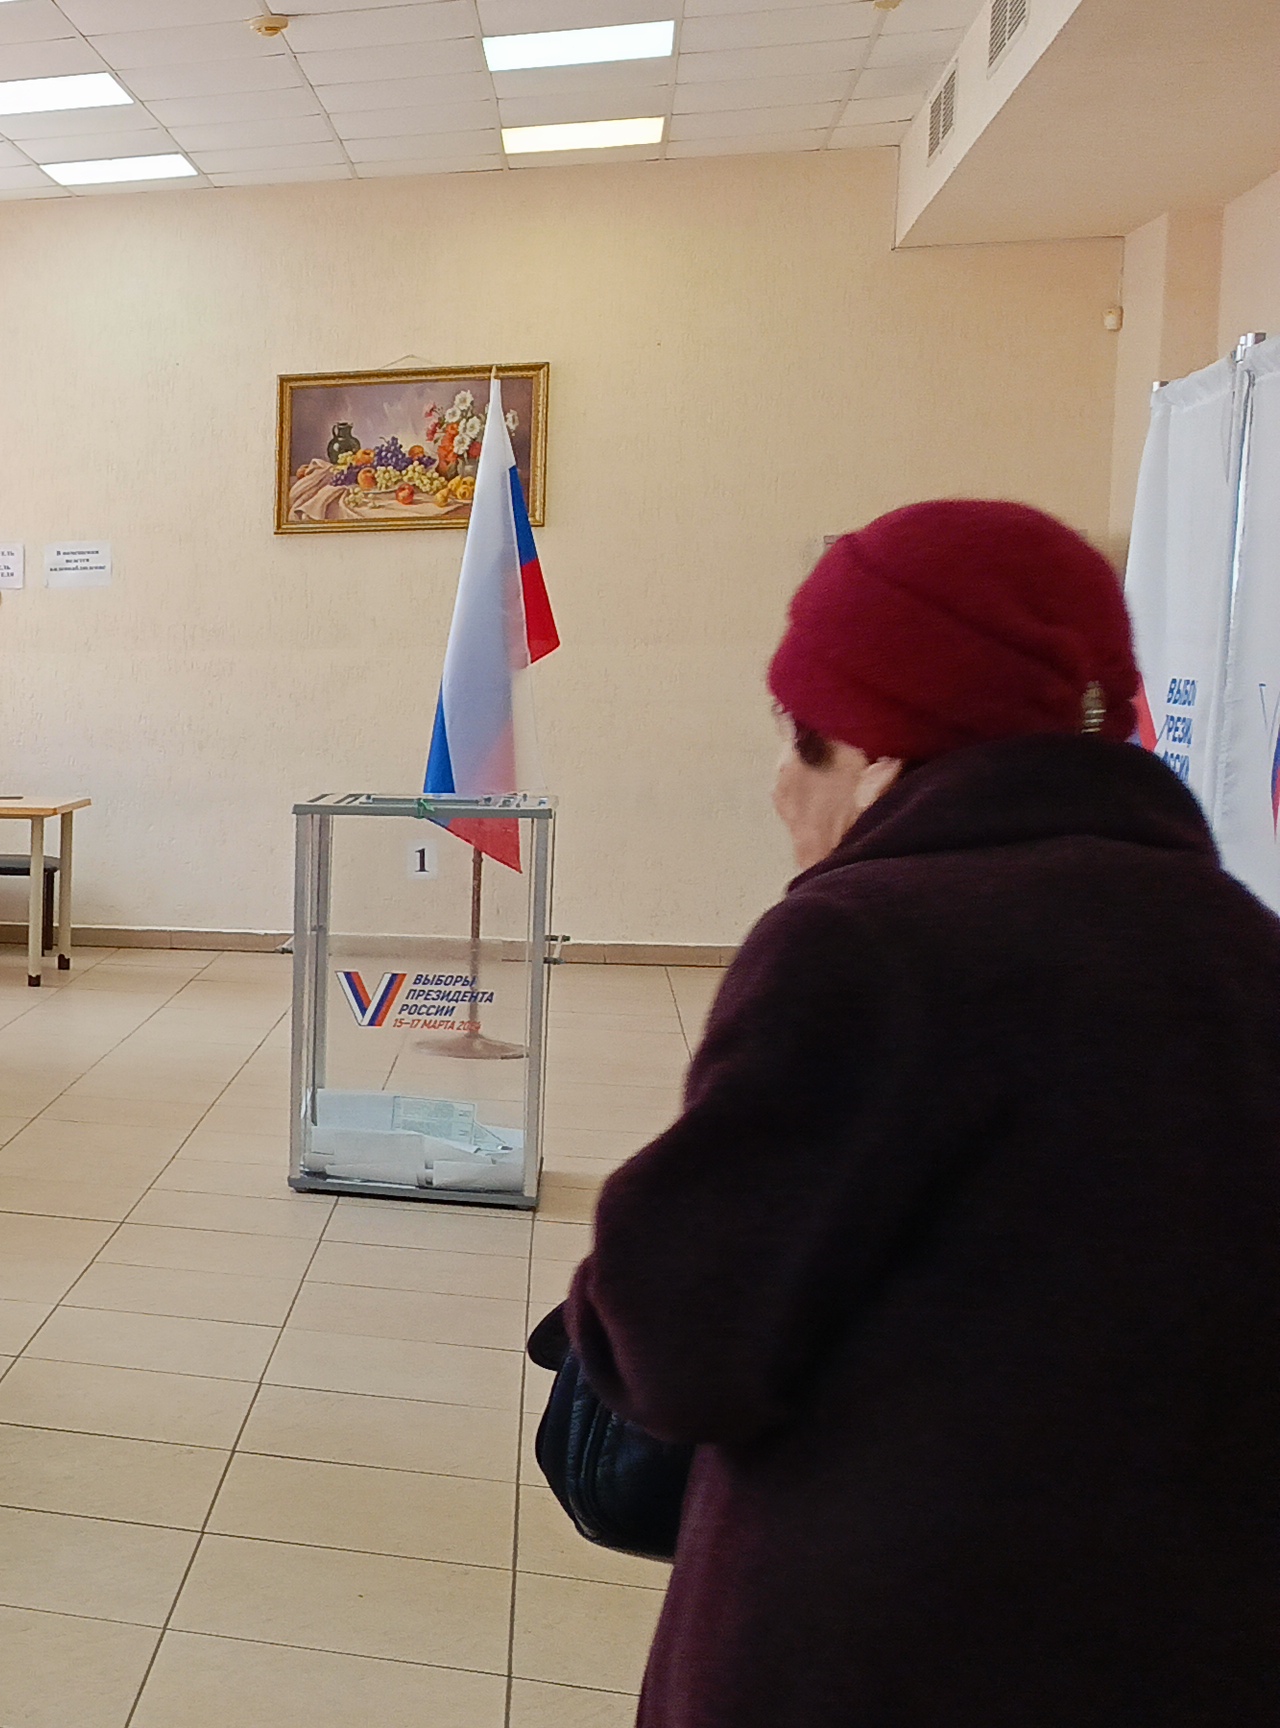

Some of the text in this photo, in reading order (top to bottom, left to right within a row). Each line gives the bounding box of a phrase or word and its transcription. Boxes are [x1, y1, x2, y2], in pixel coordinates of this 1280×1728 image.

[414, 848, 429, 873] 1
[412, 974, 477, 987] ВЫБОРЫ
[405, 989, 495, 1003] ПРЕЗИДЕНТА
[398, 1004, 456, 1017] РОССИИ
[421, 1020, 456, 1031] МАРТА
